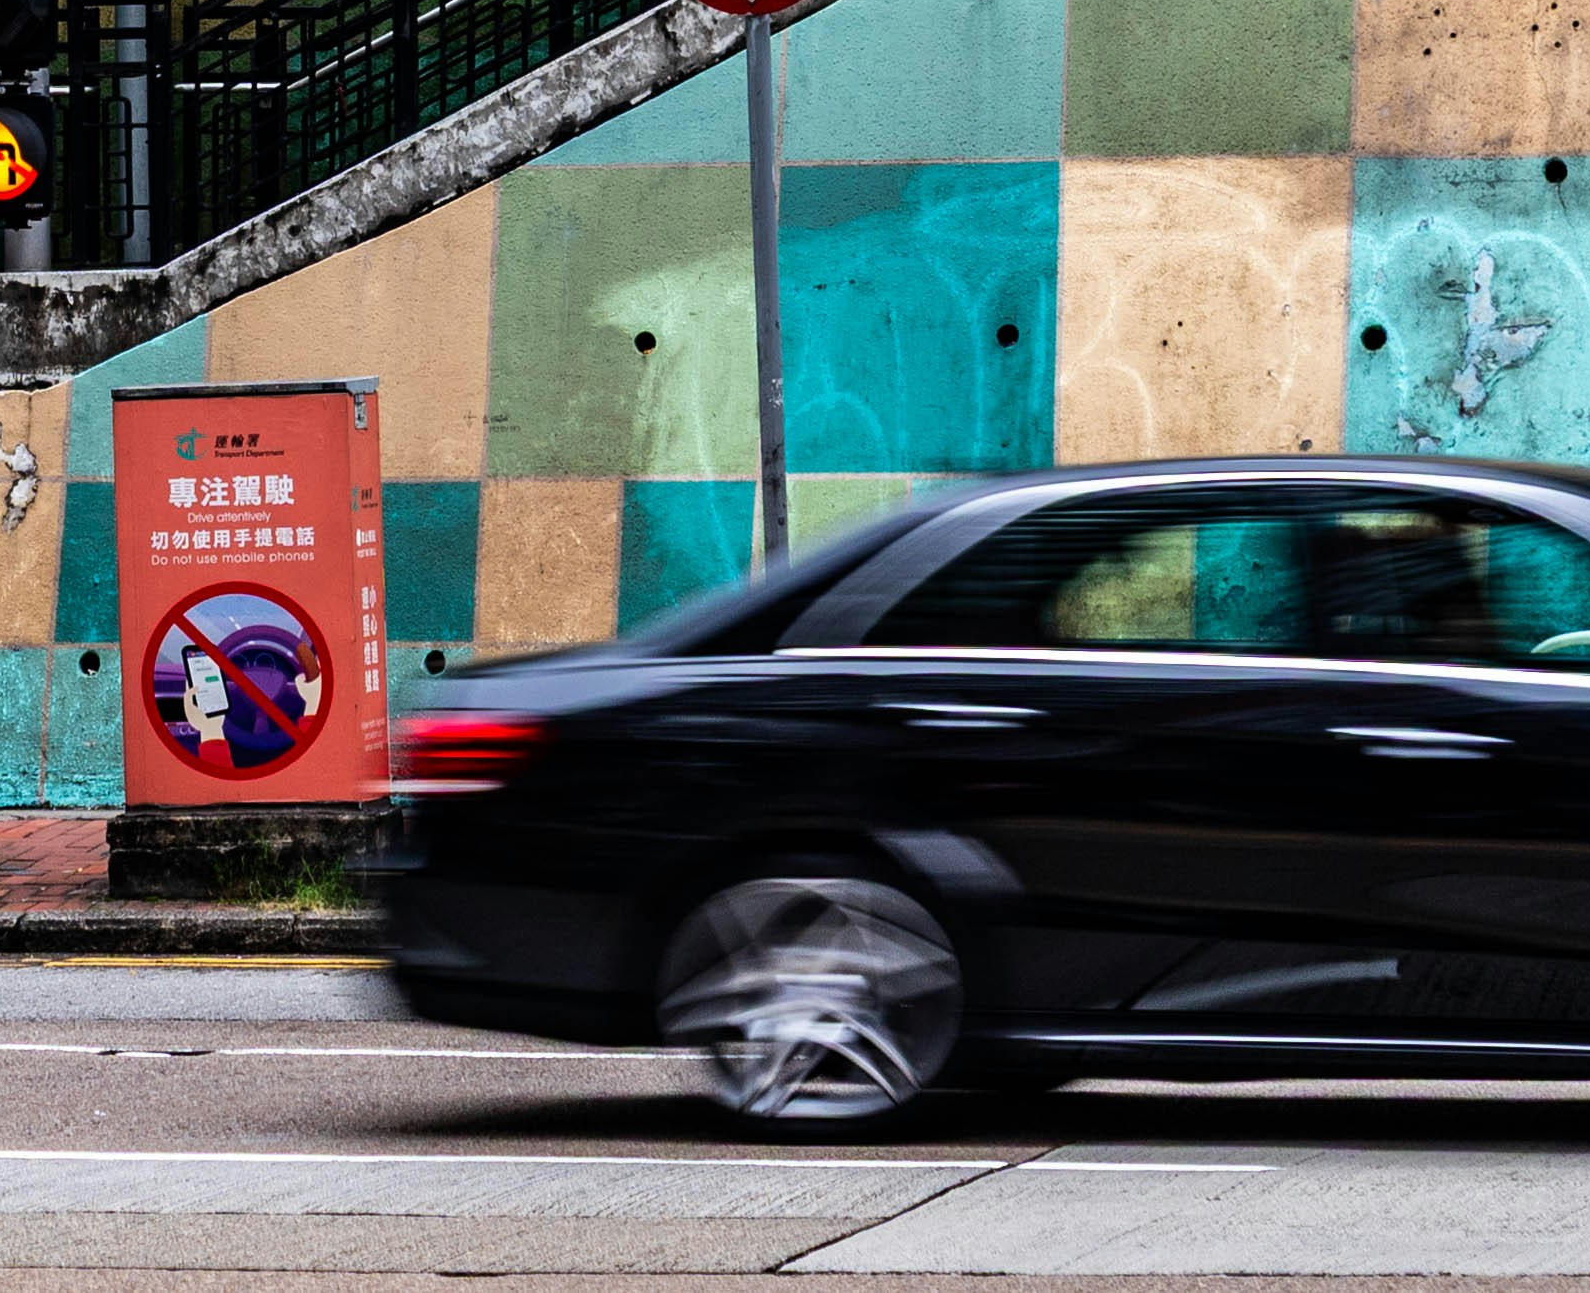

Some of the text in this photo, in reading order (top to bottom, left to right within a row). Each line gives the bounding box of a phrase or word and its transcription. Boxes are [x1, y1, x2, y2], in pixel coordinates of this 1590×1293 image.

[168, 474, 295, 508] 專注駕駛
[187, 511, 271, 523] Drive attentively
[151, 527, 315, 550] 切勿使用手提電話
[151, 551, 315, 566] Do not use mobile phones
